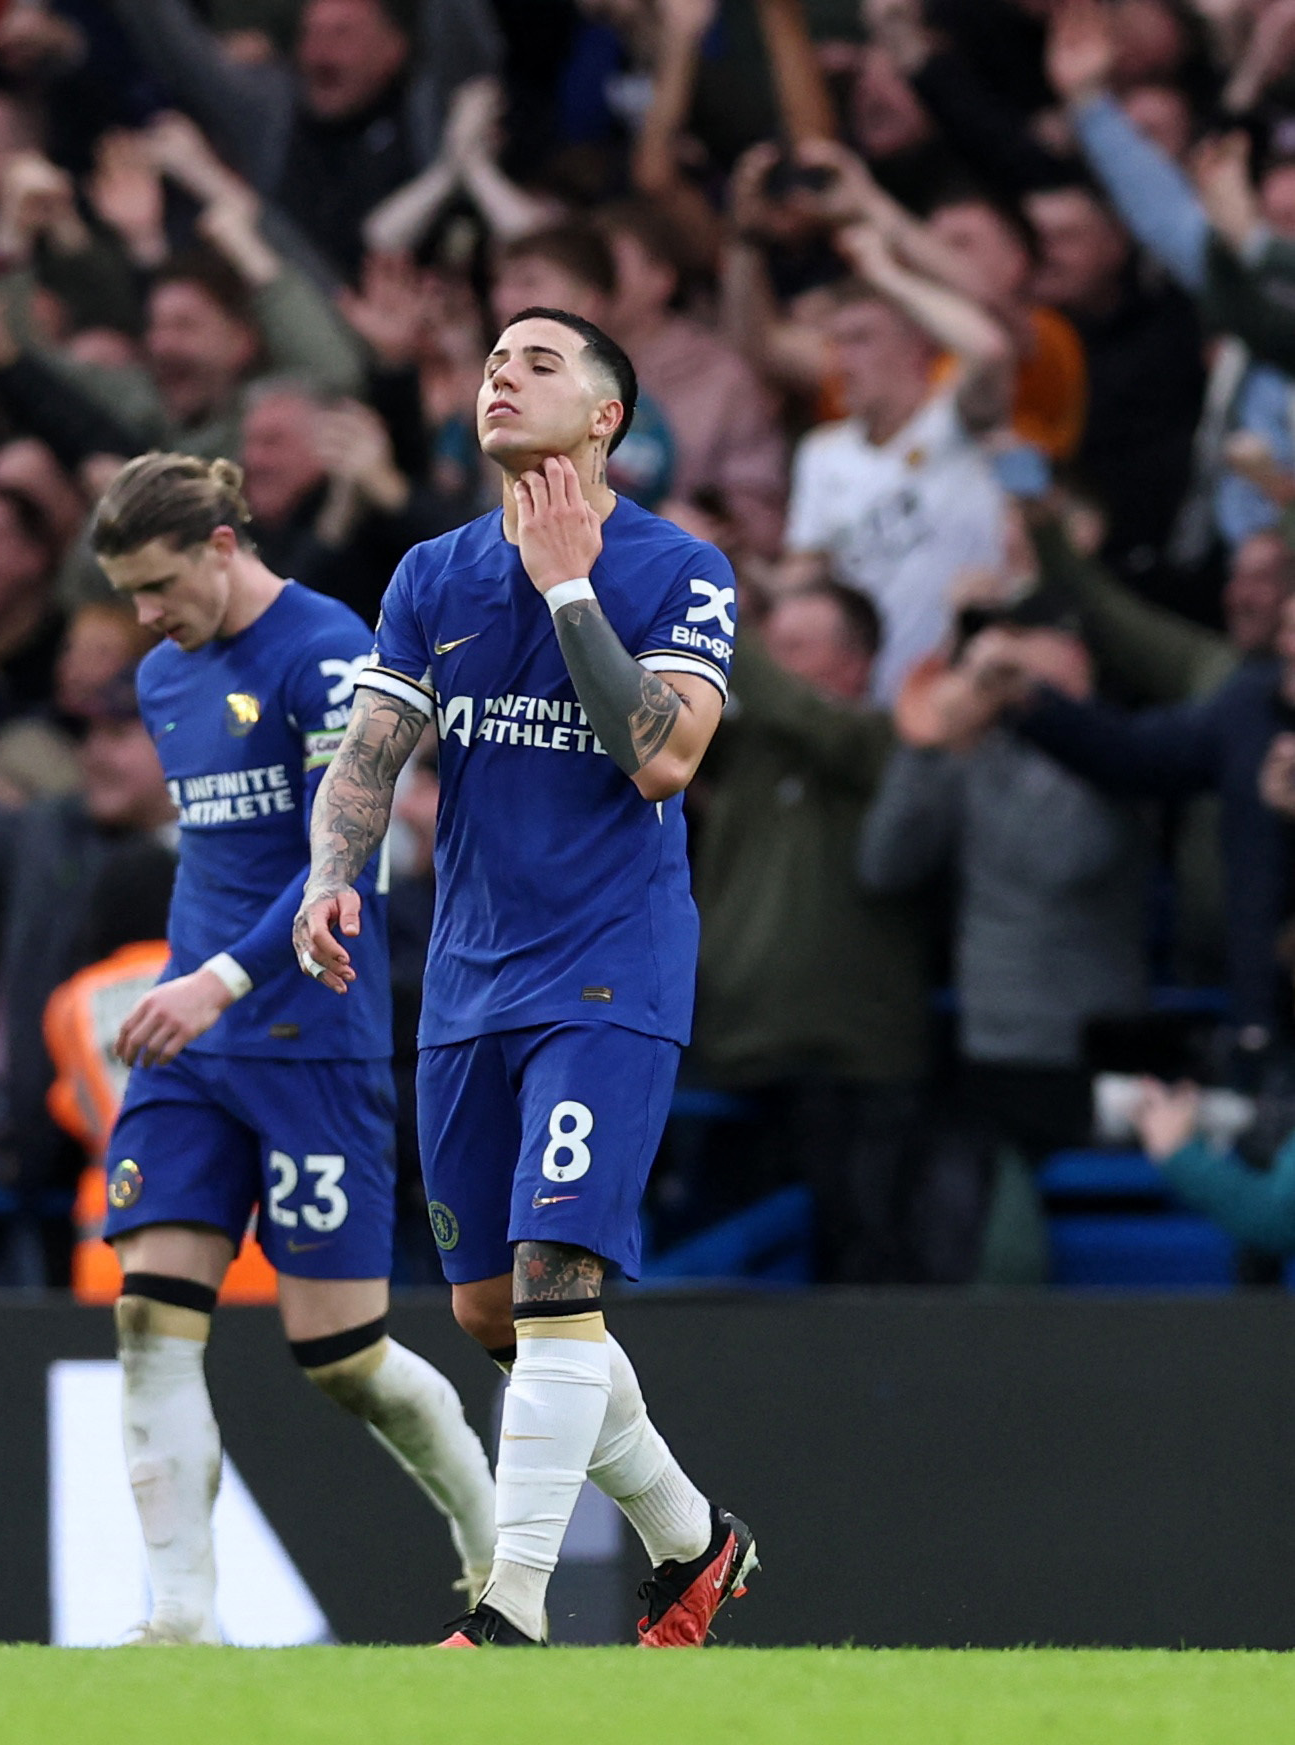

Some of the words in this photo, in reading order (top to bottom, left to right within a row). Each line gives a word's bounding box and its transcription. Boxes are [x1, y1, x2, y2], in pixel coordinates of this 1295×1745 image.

[484, 693, 588, 726] INFINIT
[184, 763, 289, 801] INFINITE
[185, 787, 296, 826] ATHLETE
[542, 1100, 594, 1183] 8
[268, 1150, 348, 1232] 23
